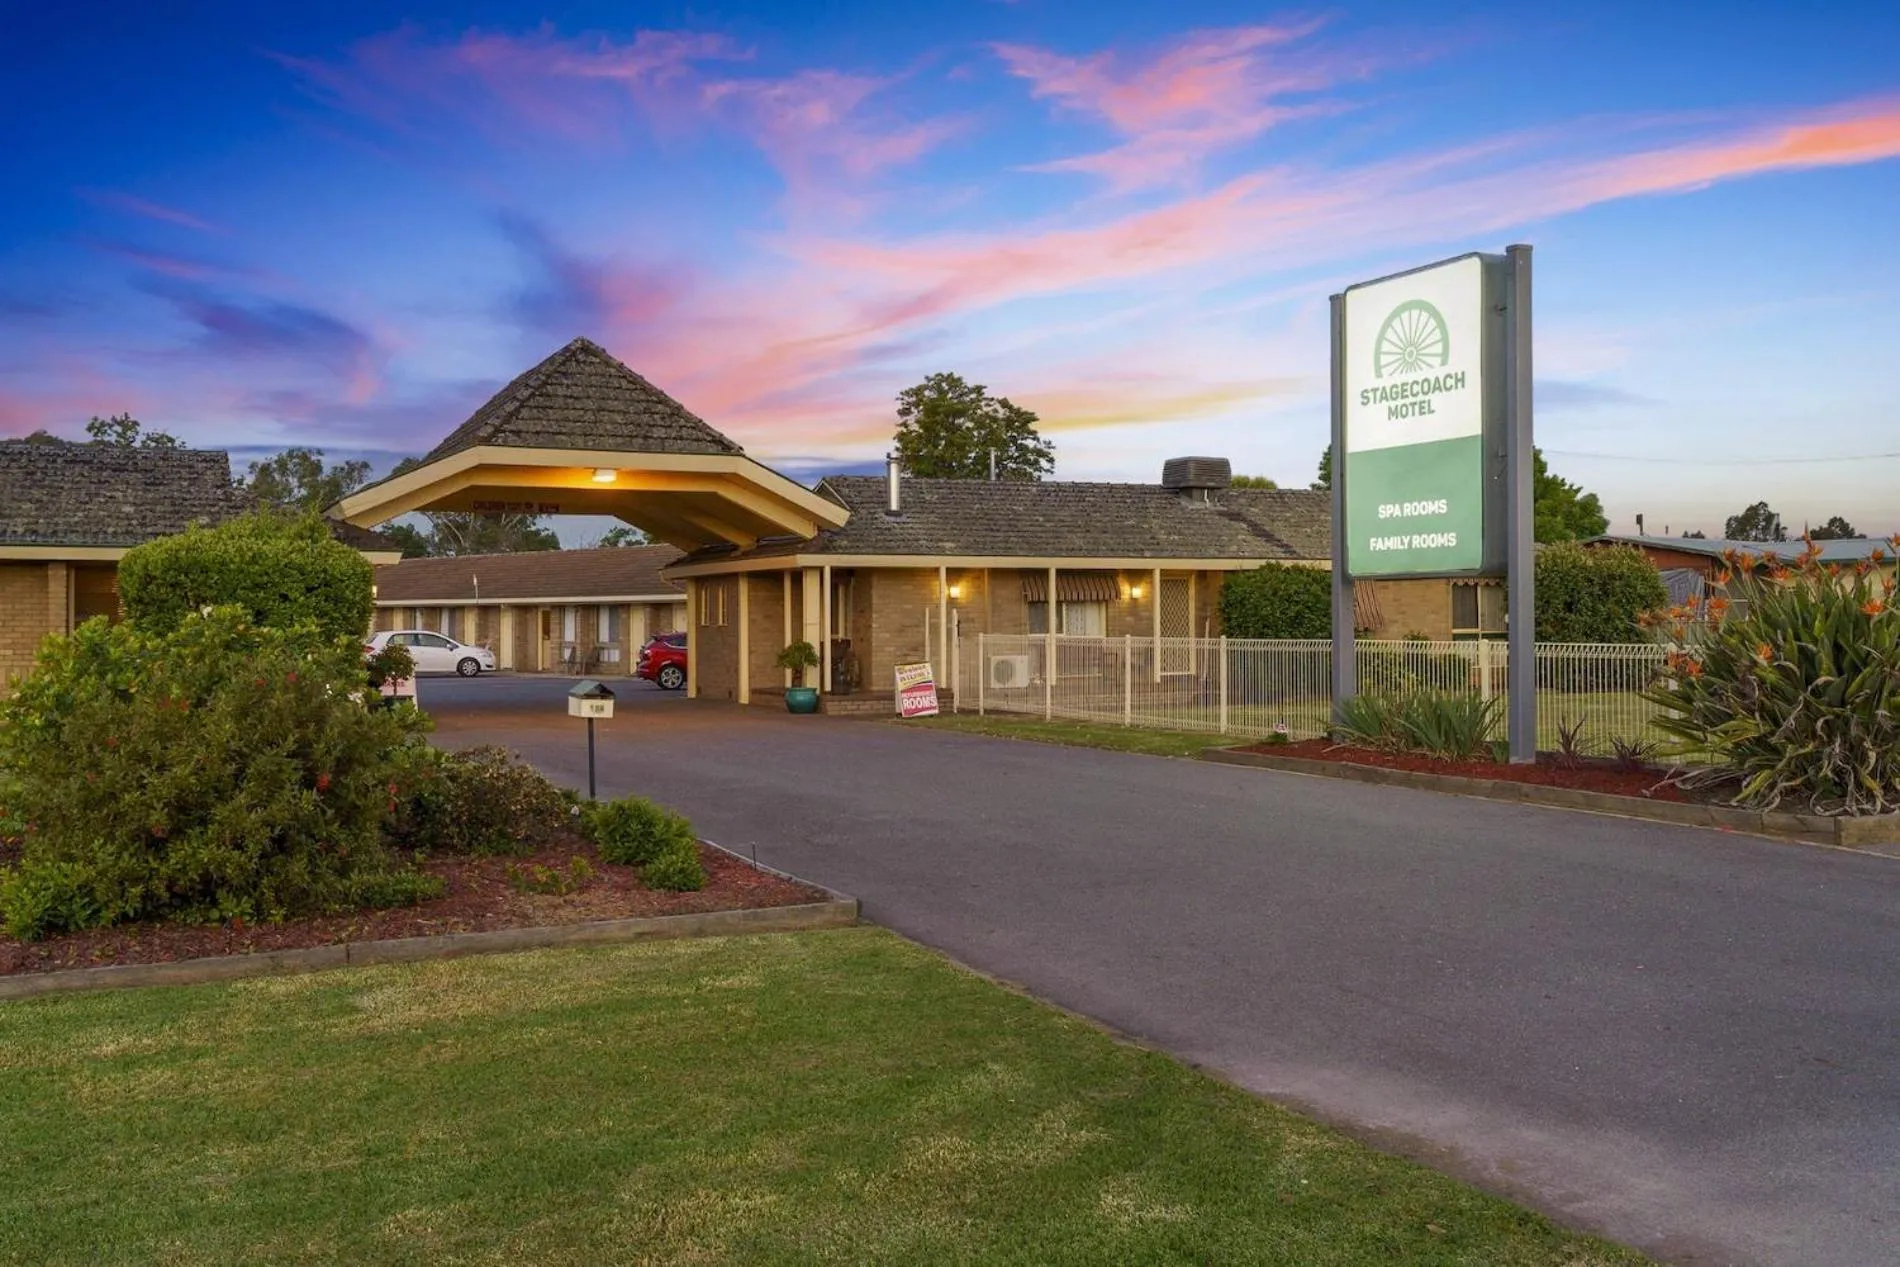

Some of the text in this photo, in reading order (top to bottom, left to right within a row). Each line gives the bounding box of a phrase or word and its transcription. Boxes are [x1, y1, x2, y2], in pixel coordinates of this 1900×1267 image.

[1360, 371, 1466, 406] STAGECOACH
[1387, 400, 1436, 421] MOTEL
[1378, 499, 1448, 519] SPA ROOMS
[1370, 532, 1457, 551] FAMILY ROOMS
[902, 697, 937, 709] ROOMS
